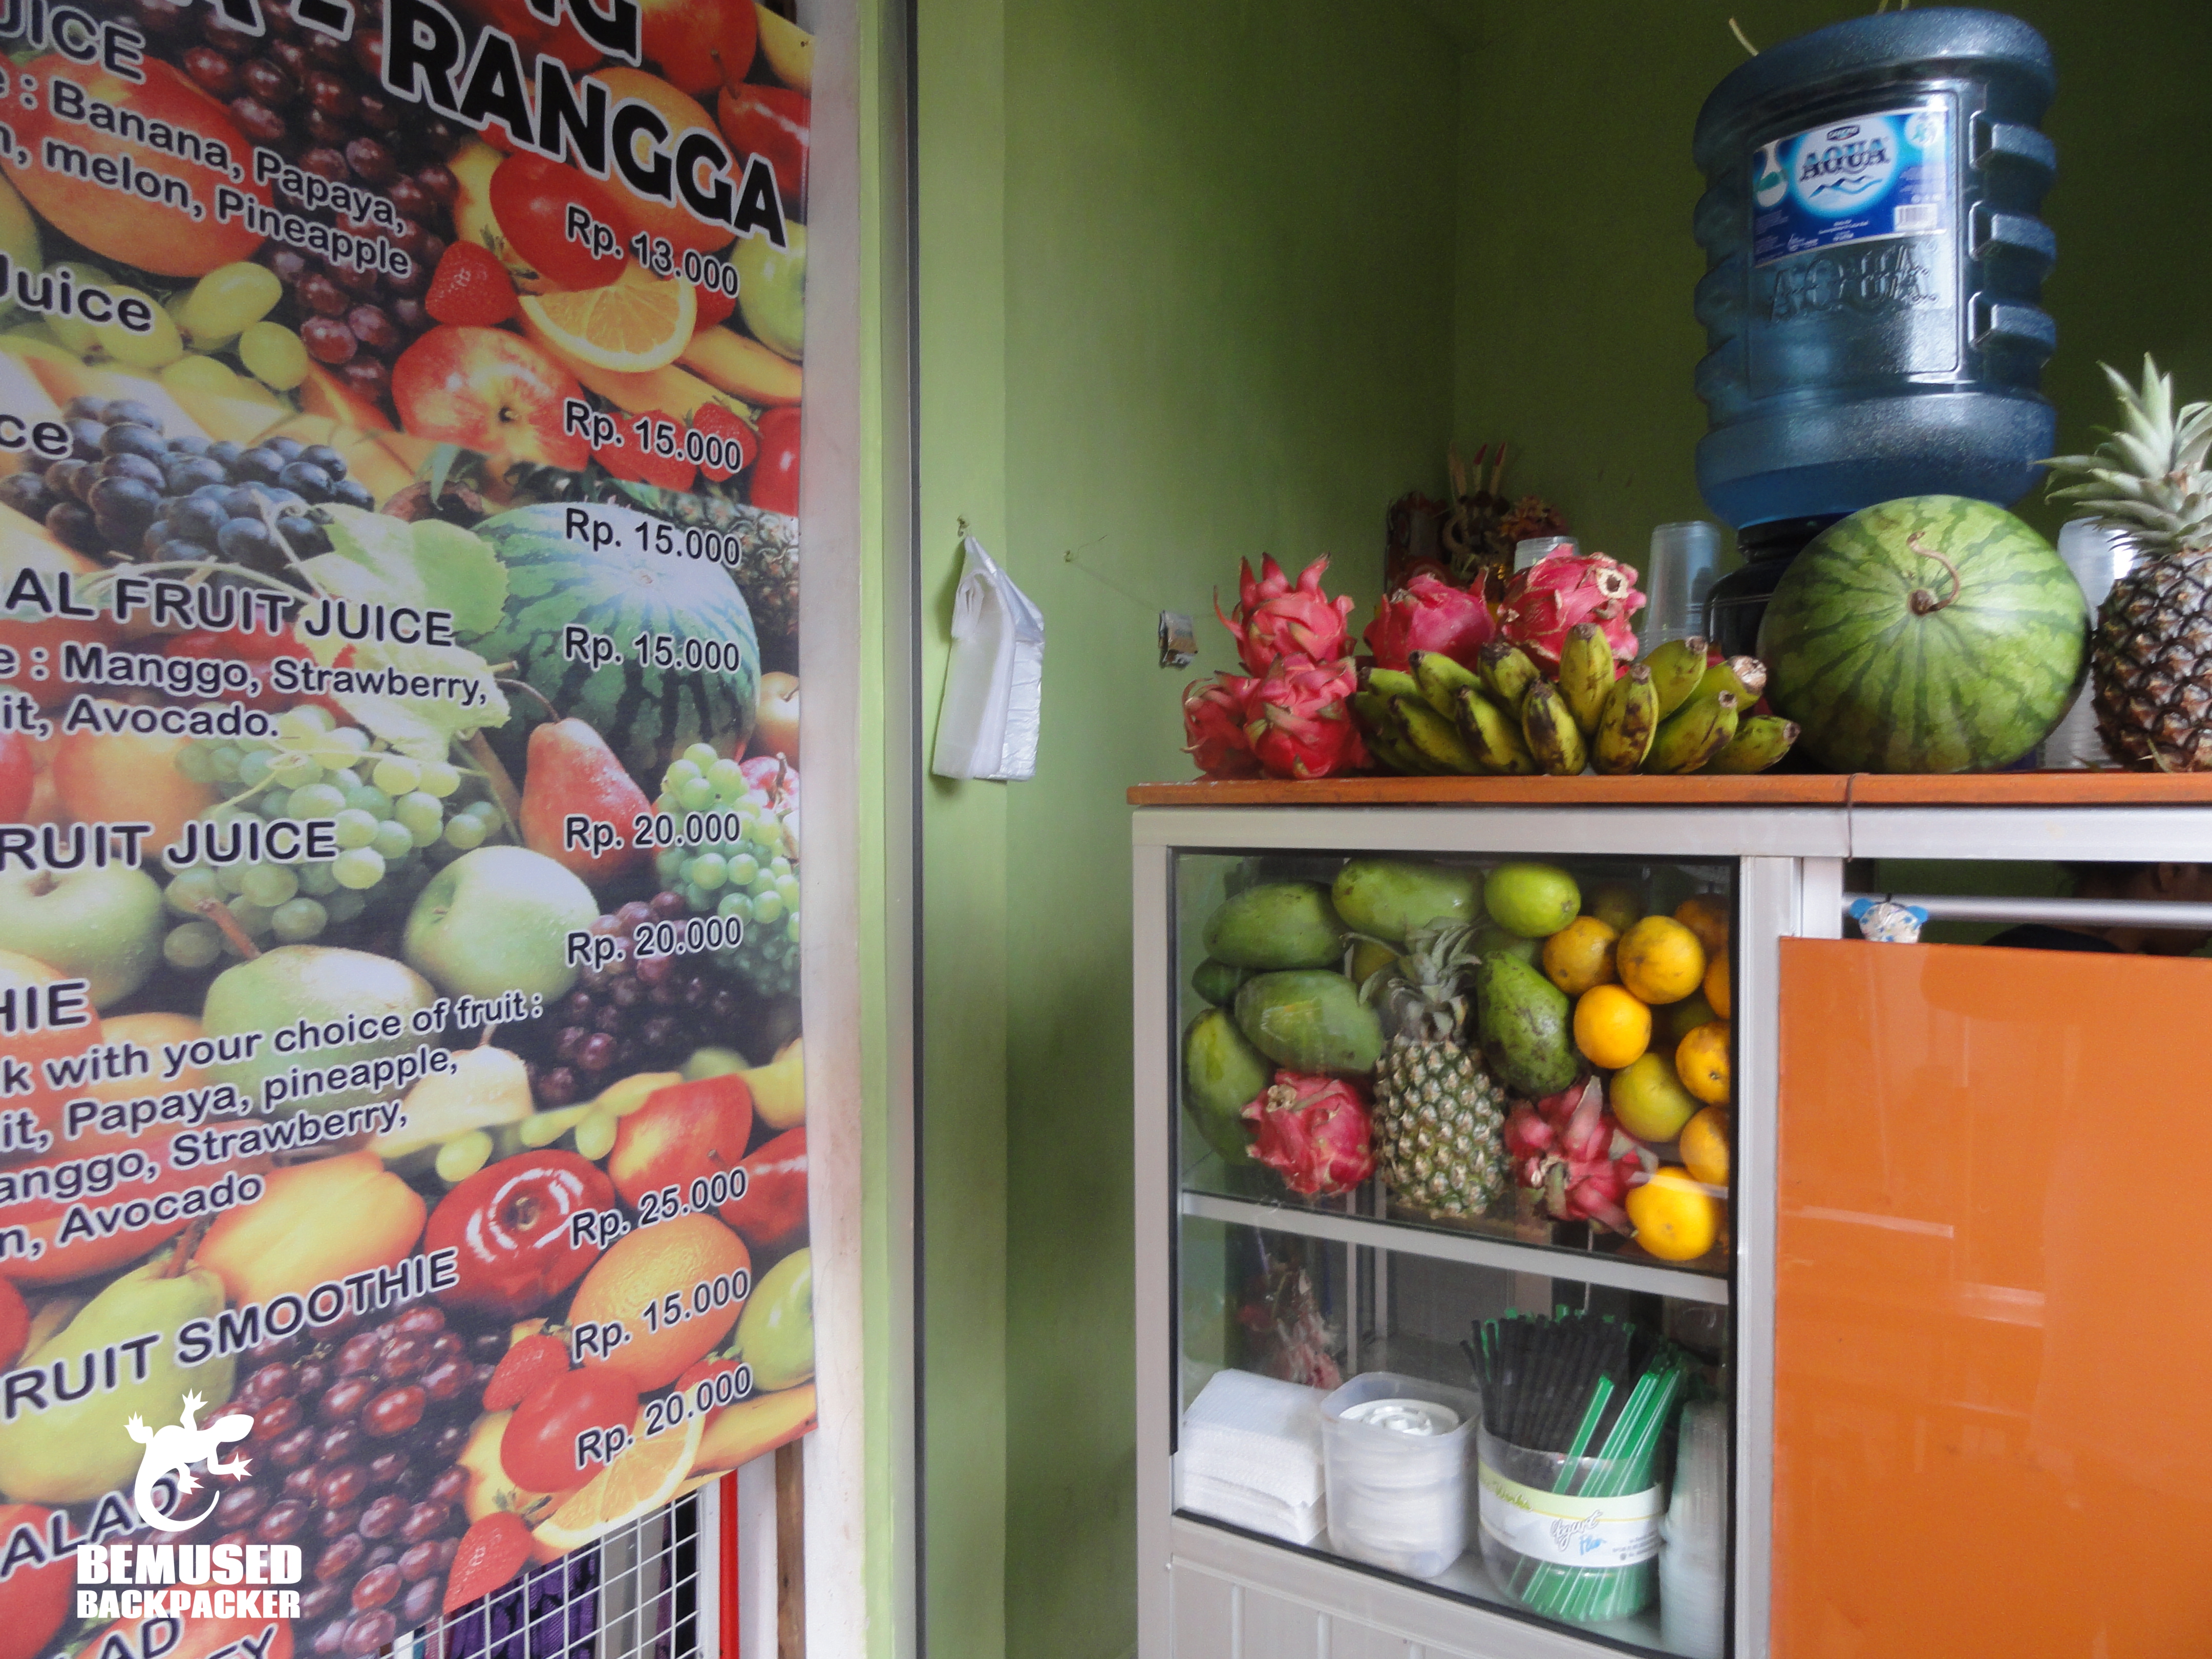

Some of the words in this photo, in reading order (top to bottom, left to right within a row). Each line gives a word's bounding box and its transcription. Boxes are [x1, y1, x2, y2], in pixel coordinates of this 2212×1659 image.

[53, 79, 243, 179] Banana,
[256, 151, 408, 233] Papaya,
[388, 0, 786, 248] RANGGA
[1800, 136, 1890, 183] AQUA
[47, 140, 204, 218] melon,
[220, 190, 411, 276] Pineapple
[568, 206, 622, 259] Rp.
[636, 234, 739, 297] 13.000
[565, 402, 622, 448] Rp.
[635, 419, 741, 471] 15.000
[565, 508, 622, 551] Rp.
[635, 521, 740, 565] 15.000
[5, 567, 96, 616] AL
[116, 579, 290, 633] FRUIT
[306, 600, 453, 646] JUICE
[65, 644, 258, 693] Manggo,
[273, 660, 487, 705] Strawberry,
[565, 627, 622, 669] Rp.
[635, 634, 740, 672] 15.000
[4, 694, 49, 727] it,
[67, 697, 279, 737] Avocado.
[0, 823, 151, 870] RUIT
[169, 820, 336, 863] JUICE
[565, 816, 623, 857] Rp.
[635, 812, 740, 845] 20.000
[567, 932, 624, 971] Rp.
[636, 917, 742, 955] 20.000
[5, 1059, 30, 1094] k
[46, 1043, 149, 1086] with
[164, 1033, 262, 1076] your
[274, 1015, 400, 1053] choice
[412, 998, 448, 1032] of
[5, 1112, 50, 1149] it,
[69, 1082, 250, 1137] Papaya,
[264, 1047, 458, 1109] pineapple,
[175, 1098, 408, 1166] Strawberry,
[58, 1173, 264, 1244] Avocado
[572, 1211, 629, 1248] Rp.
[640, 1169, 747, 1225] 25.000
[4, 1334, 160, 1419] RUIT
[176, 1249, 457, 1366] SMOOTHIE
[574, 1323, 631, 1360] Rp.
[643, 1270, 749, 1332] 15.000
[577, 1429, 634, 1466] Rp.
[645, 1367, 752, 1436] 20.000
